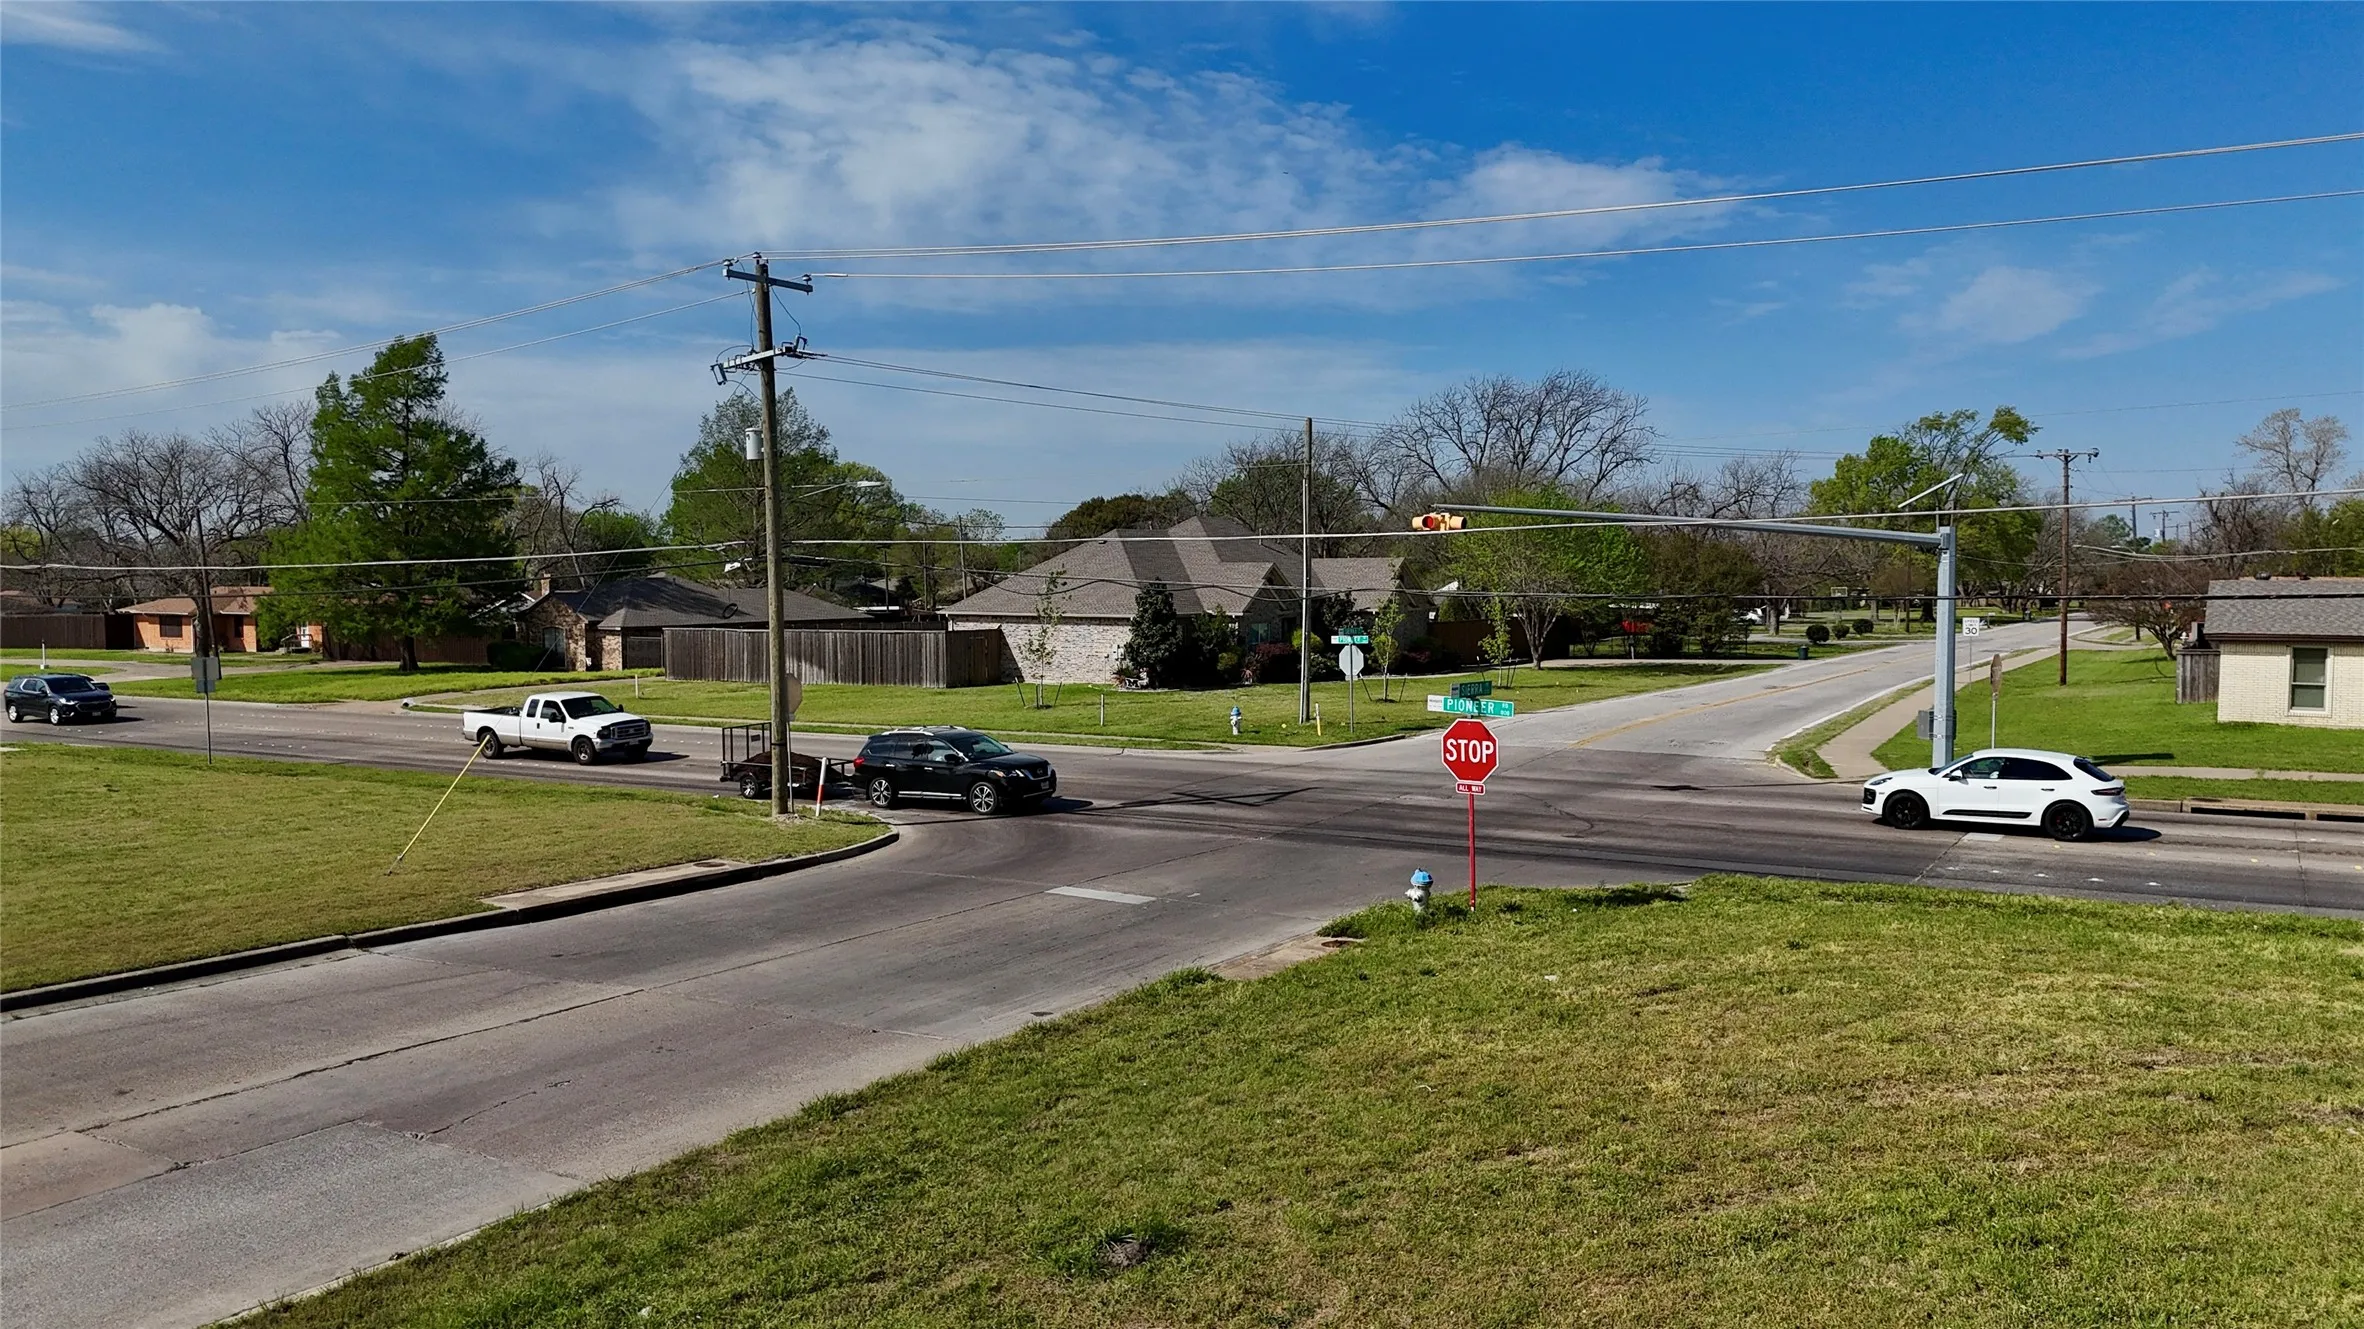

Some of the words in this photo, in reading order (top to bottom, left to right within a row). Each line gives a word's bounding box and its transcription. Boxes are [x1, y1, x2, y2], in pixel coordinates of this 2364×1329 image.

[1965, 627, 1977, 635] 30
[1461, 683, 1483, 696] SIERRA
[1447, 699, 1494, 714] PIONEER
[1445, 738, 1494, 763] STOP
[1471, 785, 1482, 793] WAY
